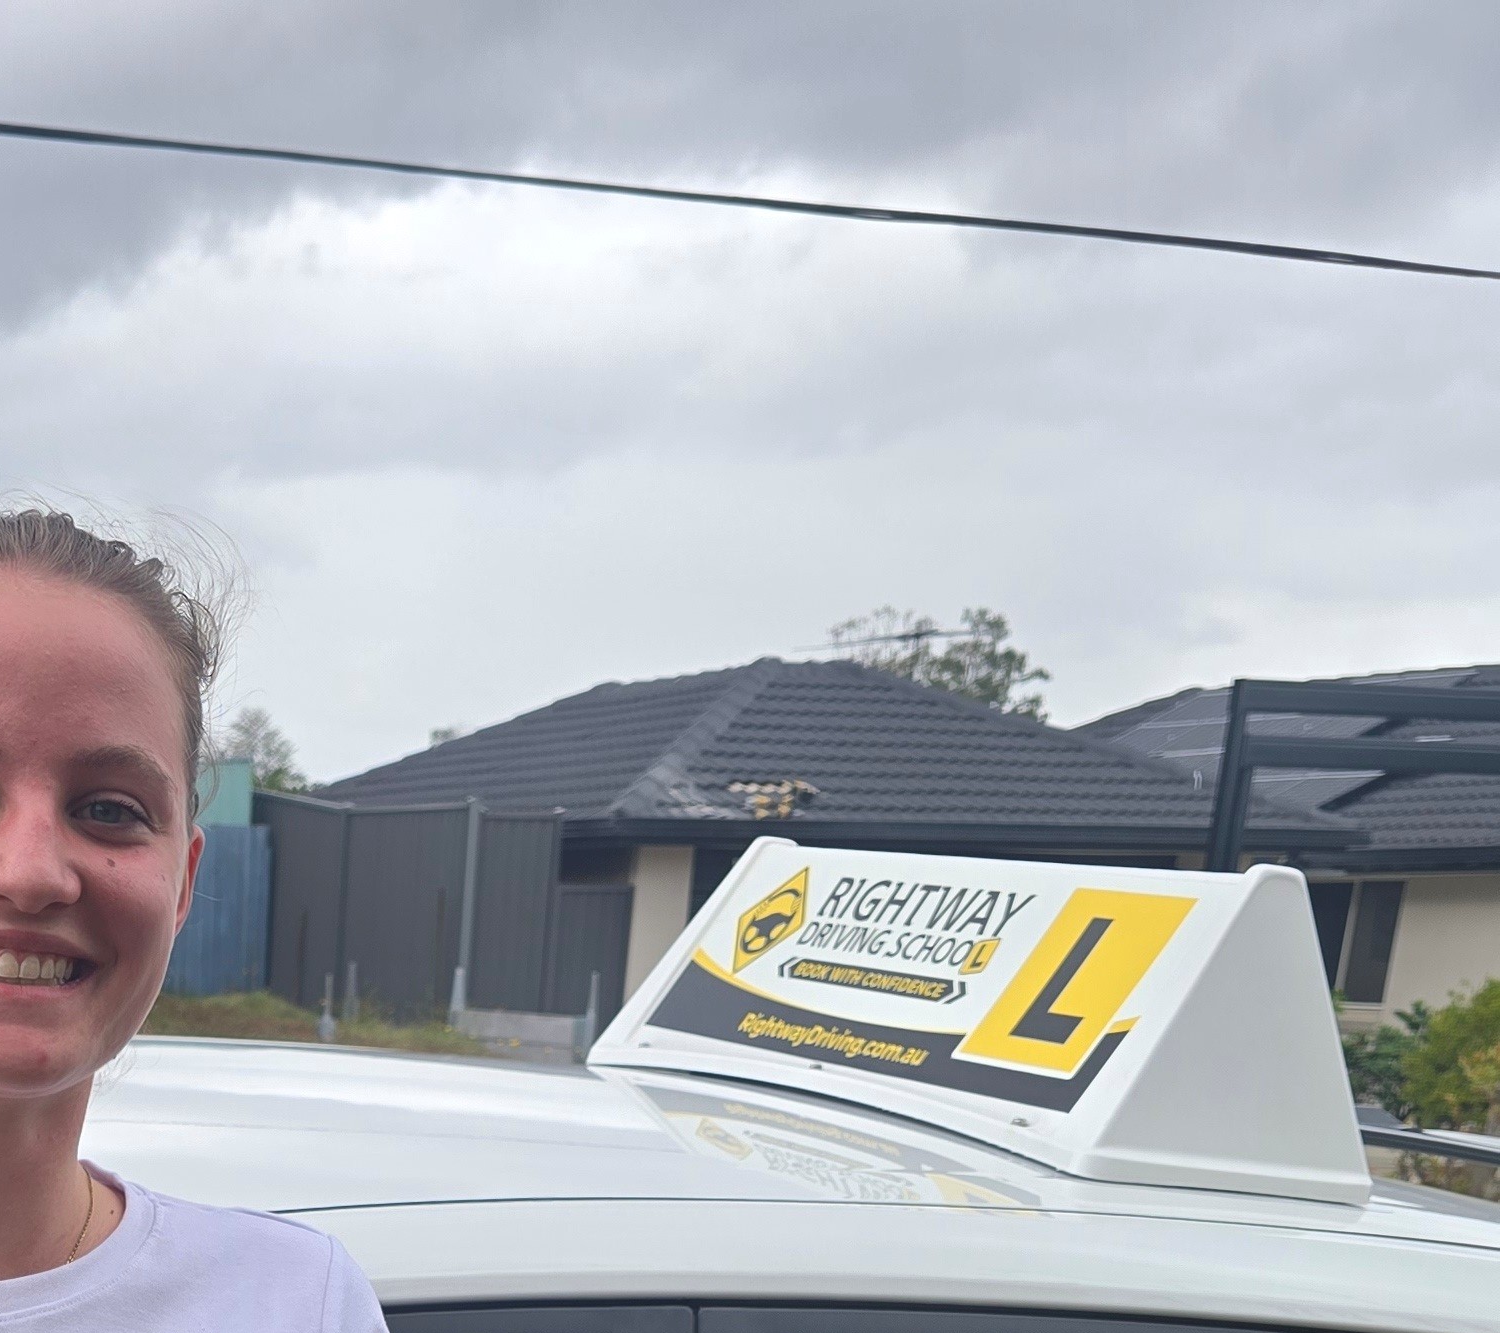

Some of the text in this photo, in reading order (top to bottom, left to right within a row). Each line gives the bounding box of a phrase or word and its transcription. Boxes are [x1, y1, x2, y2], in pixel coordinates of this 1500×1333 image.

[816, 876, 1038, 937] RIGHTWAY
[796, 921, 990, 971] DRIVING SCHOOL
[793, 961, 948, 999] BOOK WITH CONFIDENCE
[1008, 917, 1114, 1045] L
[737, 1012, 930, 1067] RightwayDriving.com.au
